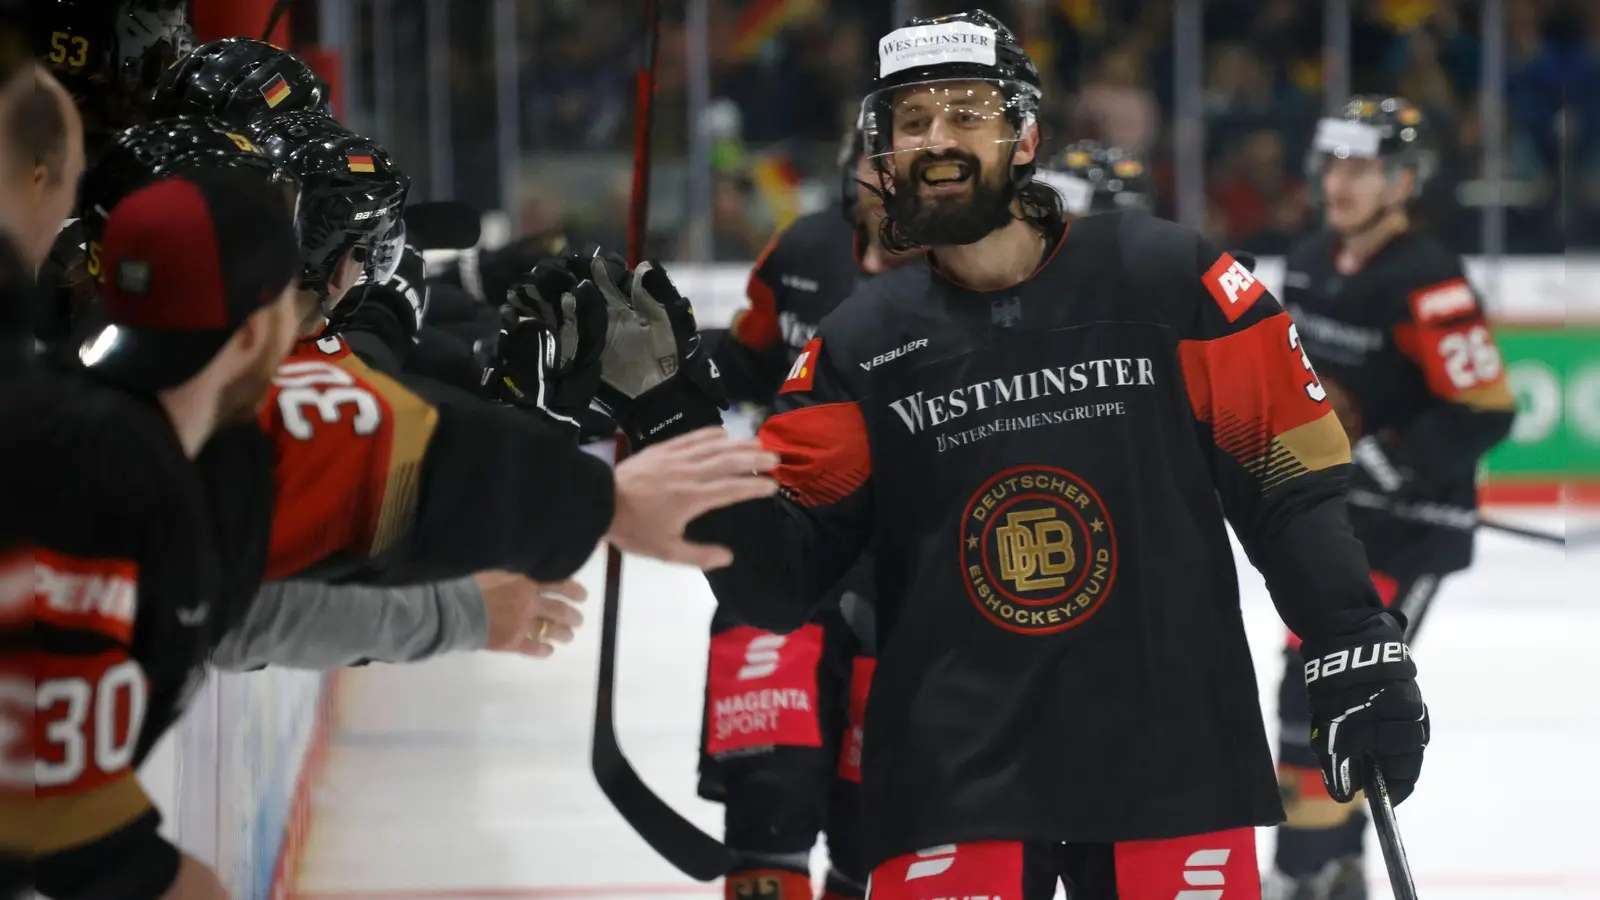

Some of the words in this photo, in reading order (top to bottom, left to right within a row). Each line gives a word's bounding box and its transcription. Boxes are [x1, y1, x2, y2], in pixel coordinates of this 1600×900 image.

[49, 31, 89, 67] 53
[1438, 327, 1501, 389] 26
[888, 358, 1156, 435] WESTMINSTER
[936, 401, 1127, 453] UNTERNEHMENSGRUPPE
[972, 475, 1092, 522] DEUTSCHER
[969, 548, 1110, 625] EISHOCKEY-BUND
[715, 687, 811, 718] MAGENTA
[715, 708, 779, 741] SPORT
